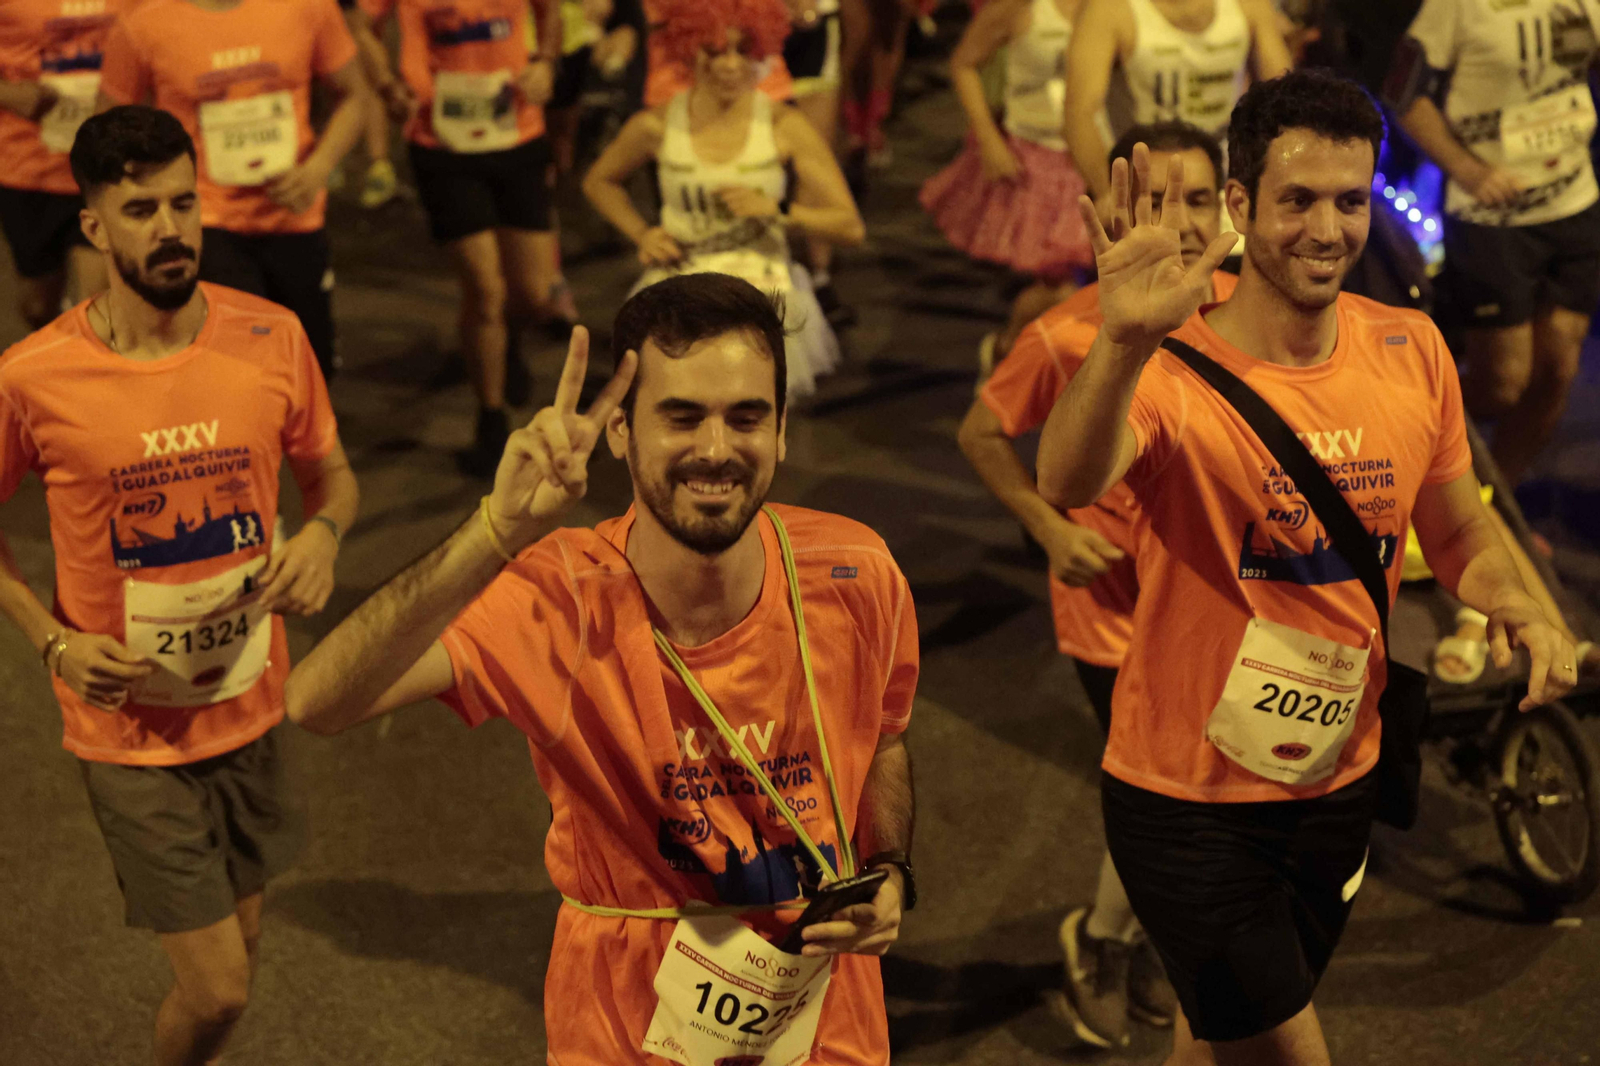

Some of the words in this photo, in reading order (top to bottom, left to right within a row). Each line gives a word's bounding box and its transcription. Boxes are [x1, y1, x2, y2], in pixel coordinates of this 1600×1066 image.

[141, 419, 219, 458] XXXV
[1296, 427, 1363, 460] XXV
[110, 459, 174, 477] CARRERA
[179, 446, 250, 464] NOCTURNA
[122, 458, 251, 491] GUADALQUIVIR
[1322, 458, 1394, 474] NOCTURNA
[1241, 568, 1267, 579] 2023
[156, 612, 249, 655] 21324
[1261, 663, 1288, 677] CARRERA
[1253, 683, 1355, 727] 20205
[674, 720, 776, 760] XXXV
[679, 943, 697, 959] XXXV
[696, 954, 724, 977] CARRERA
[723, 971, 762, 993] NOCTURNA
[762, 988, 774, 999] DEL
[689, 1020, 730, 1042] ANTONIO
